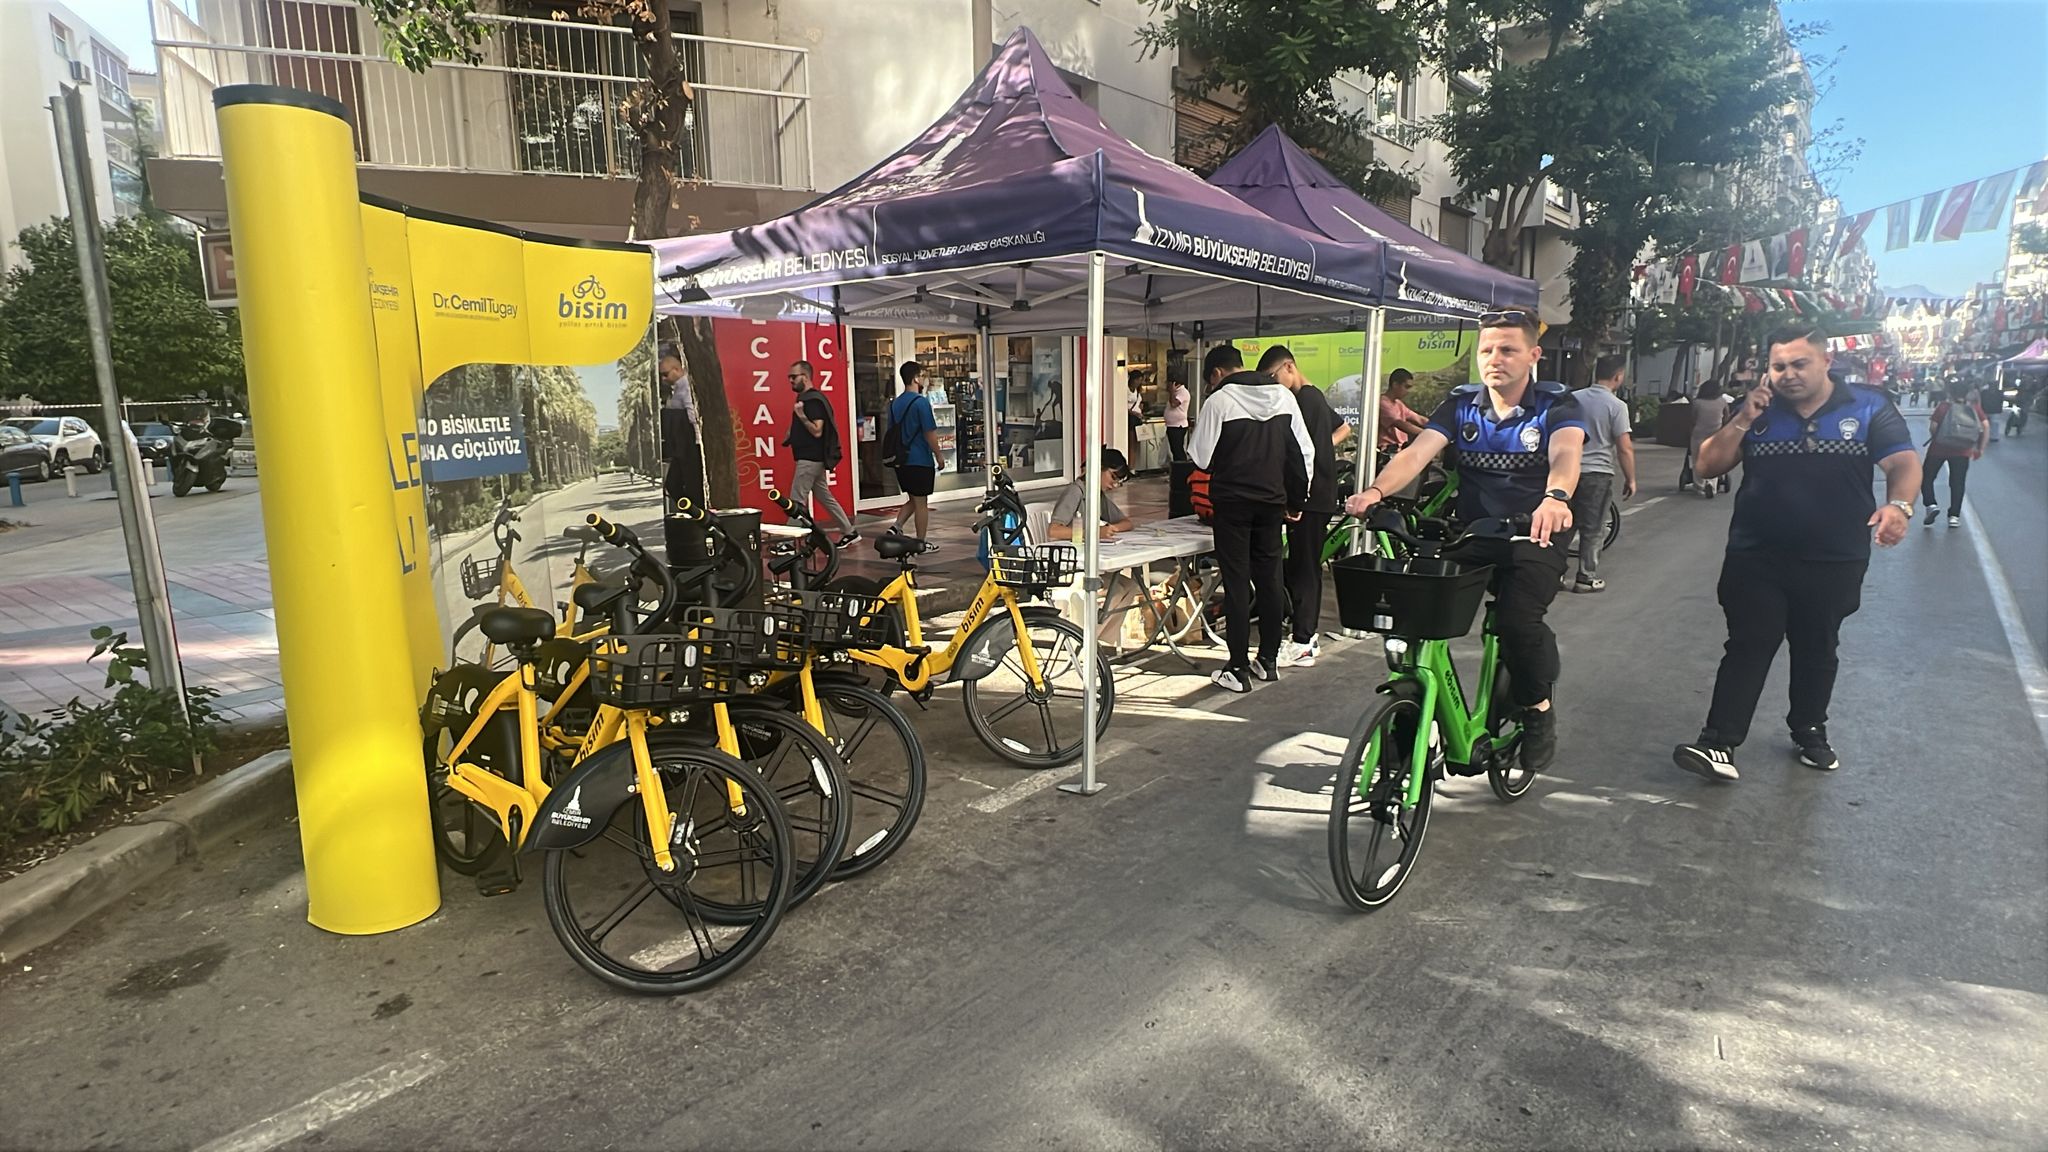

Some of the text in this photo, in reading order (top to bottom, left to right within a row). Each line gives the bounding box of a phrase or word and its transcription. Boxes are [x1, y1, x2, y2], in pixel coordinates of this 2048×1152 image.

[784, 246, 869, 277] BELEDİYESİ
[882, 252, 912, 265] SOSYAL
[990, 230, 1045, 249] BAŞKANLIĞI
[1153, 225, 1311, 281] İZMİR BÜYÜKŞEHİR BELEDİYESİ
[559, 293, 627, 319] bisim
[1418, 339, 1456, 349] bisim
[751, 319, 775, 490] CZANE
[441, 414, 511, 436] BİSİKLETLE
[452, 436, 521, 461] GÜÇLÜYÜZ
[961, 597, 984, 633] bisim
